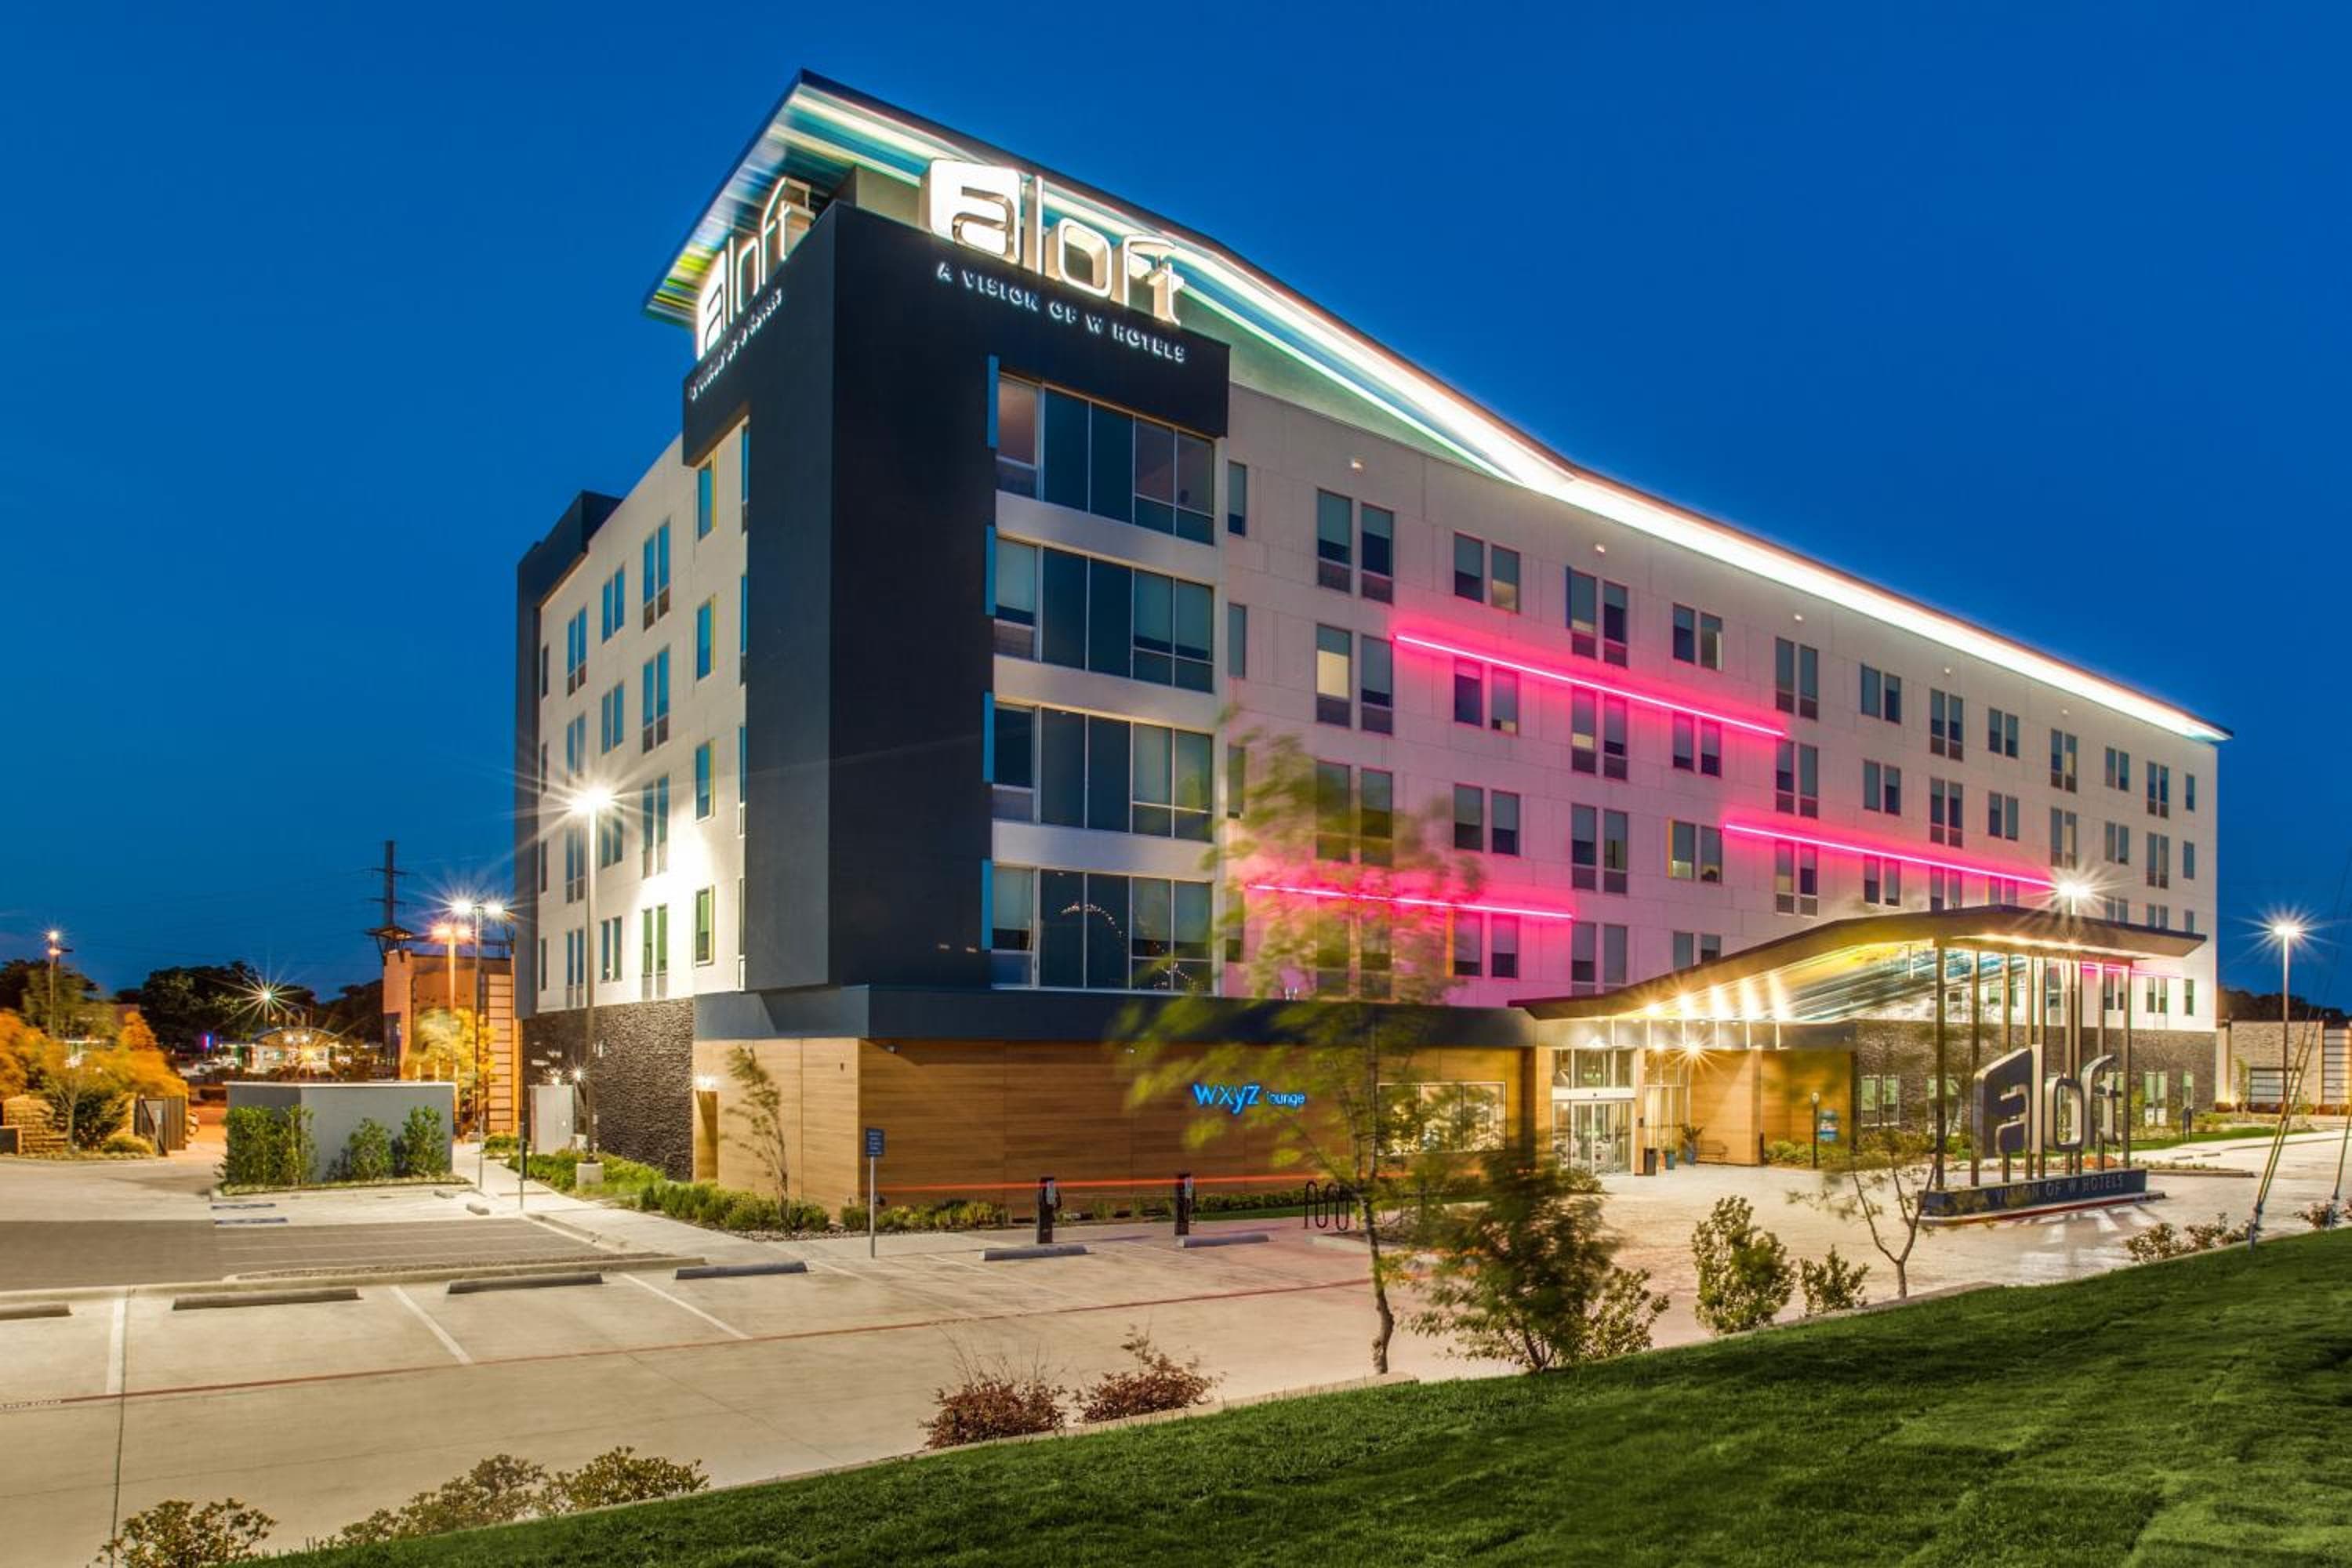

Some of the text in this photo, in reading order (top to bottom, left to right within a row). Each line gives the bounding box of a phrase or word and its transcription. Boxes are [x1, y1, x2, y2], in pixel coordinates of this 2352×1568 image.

[930, 158, 1185, 326] aloft
[937, 261, 953, 283] A
[962, 269, 1039, 312] VISION
[1086, 314, 1105, 335] W
[1112, 322, 1186, 363] HOTELS
[1973, 1044, 2123, 1159] aloft
[2082, 1173, 2123, 1192] HOTELS
